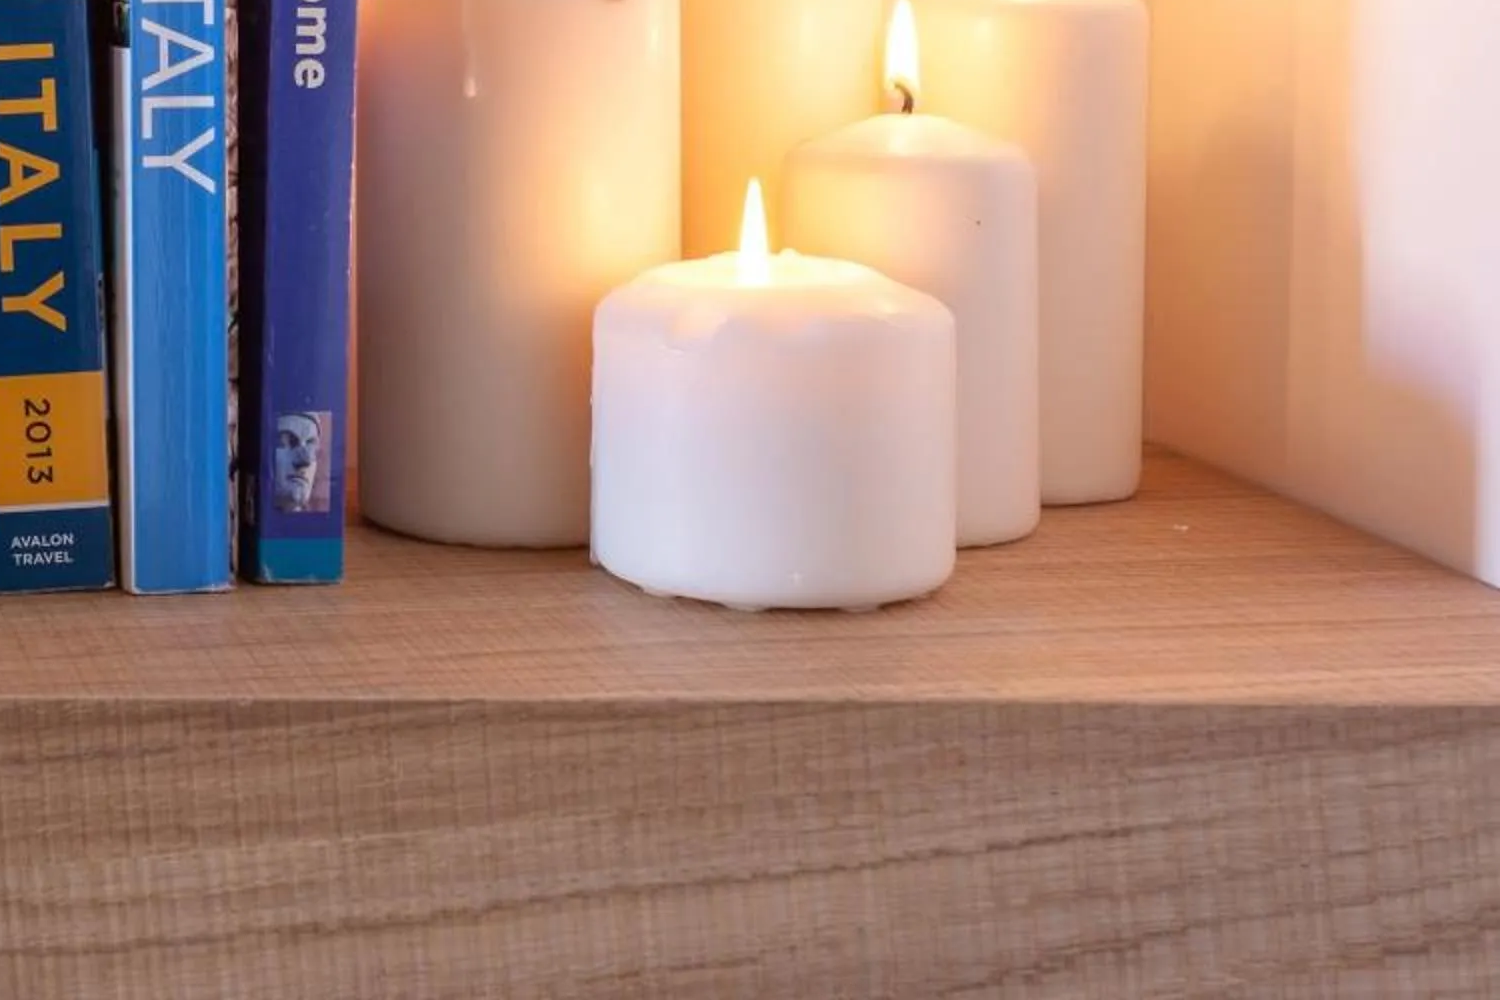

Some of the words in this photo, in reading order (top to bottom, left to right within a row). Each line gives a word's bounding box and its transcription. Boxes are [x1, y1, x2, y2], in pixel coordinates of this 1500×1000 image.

[24, 398, 54, 485] 2013
[11, 533, 75, 549] AVALON
[13, 550, 74, 567] TRAVEL
